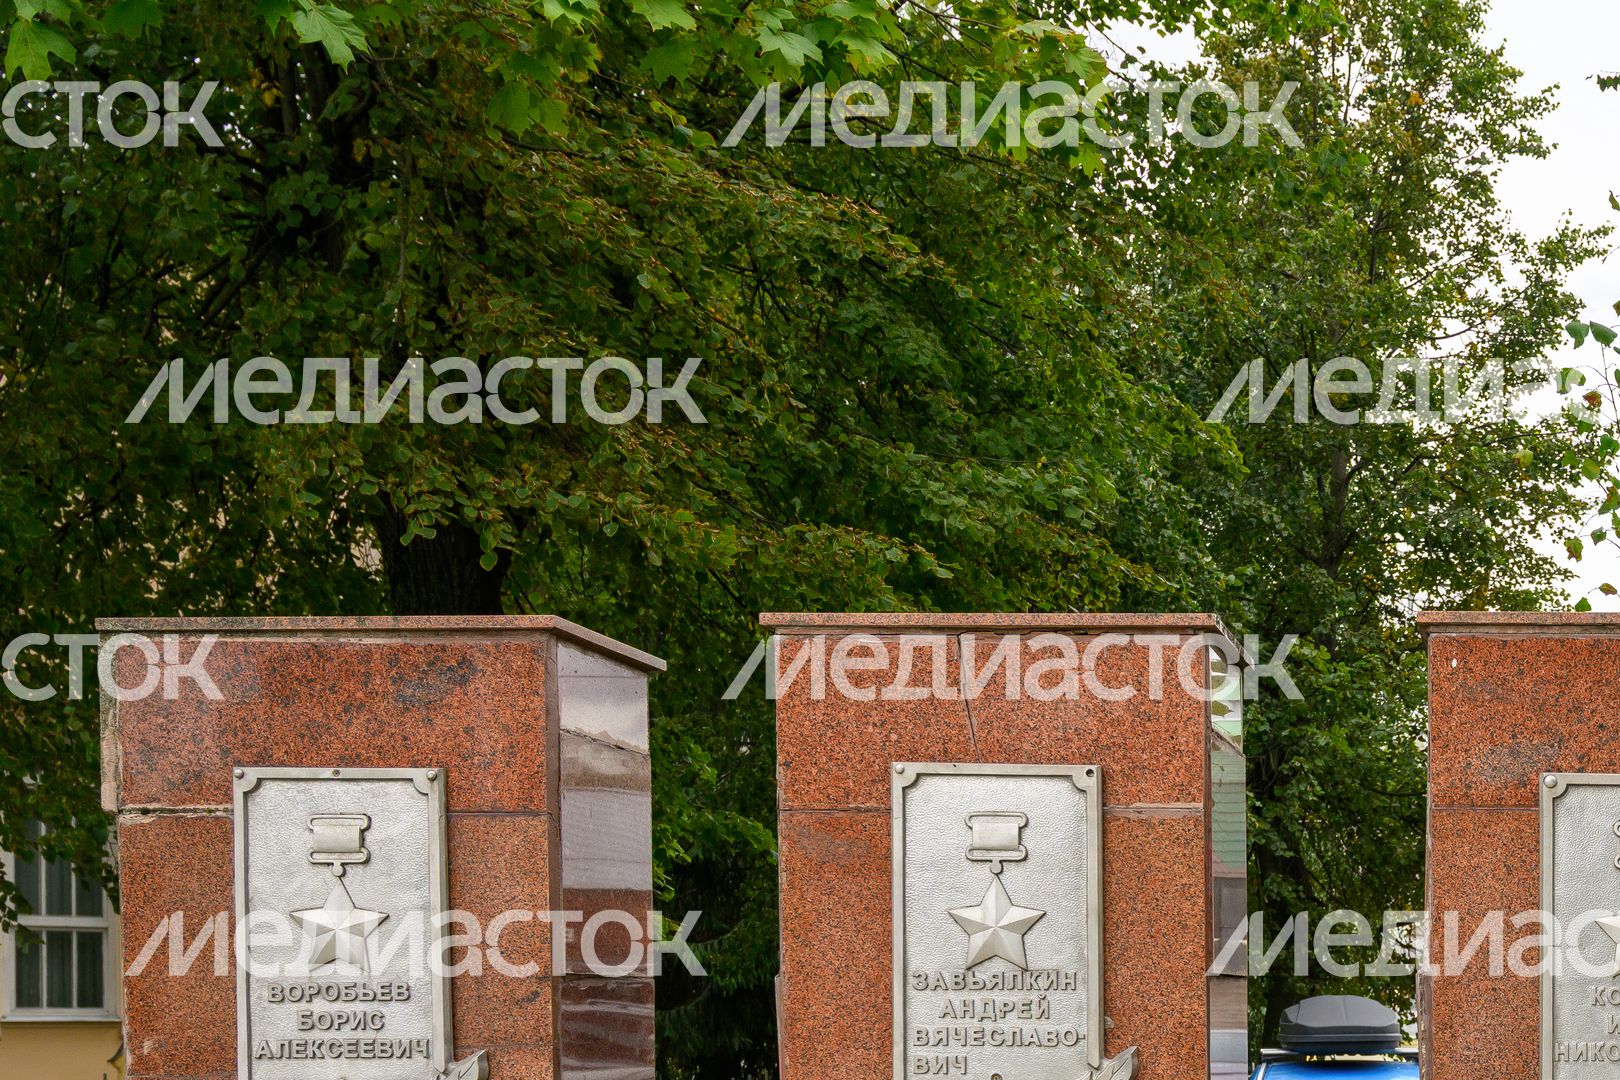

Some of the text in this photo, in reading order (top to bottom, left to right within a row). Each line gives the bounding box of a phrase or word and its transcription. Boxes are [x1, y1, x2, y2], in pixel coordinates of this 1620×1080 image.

[912, 969, 1077, 992] ЗАВЬЯЛКИН
[267, 981, 411, 1003] ВОРОБЬЕВ
[938, 994, 1051, 1022] АНДРЕЙ
[297, 1010, 385, 1031] БОРИС
[912, 1026, 1086, 1047] ВЯЧЕСЛАВО-
[254, 1038, 430, 1060] АЛЕКСЕЕВИЧ
[912, 1055, 968, 1076] ВИЧ
